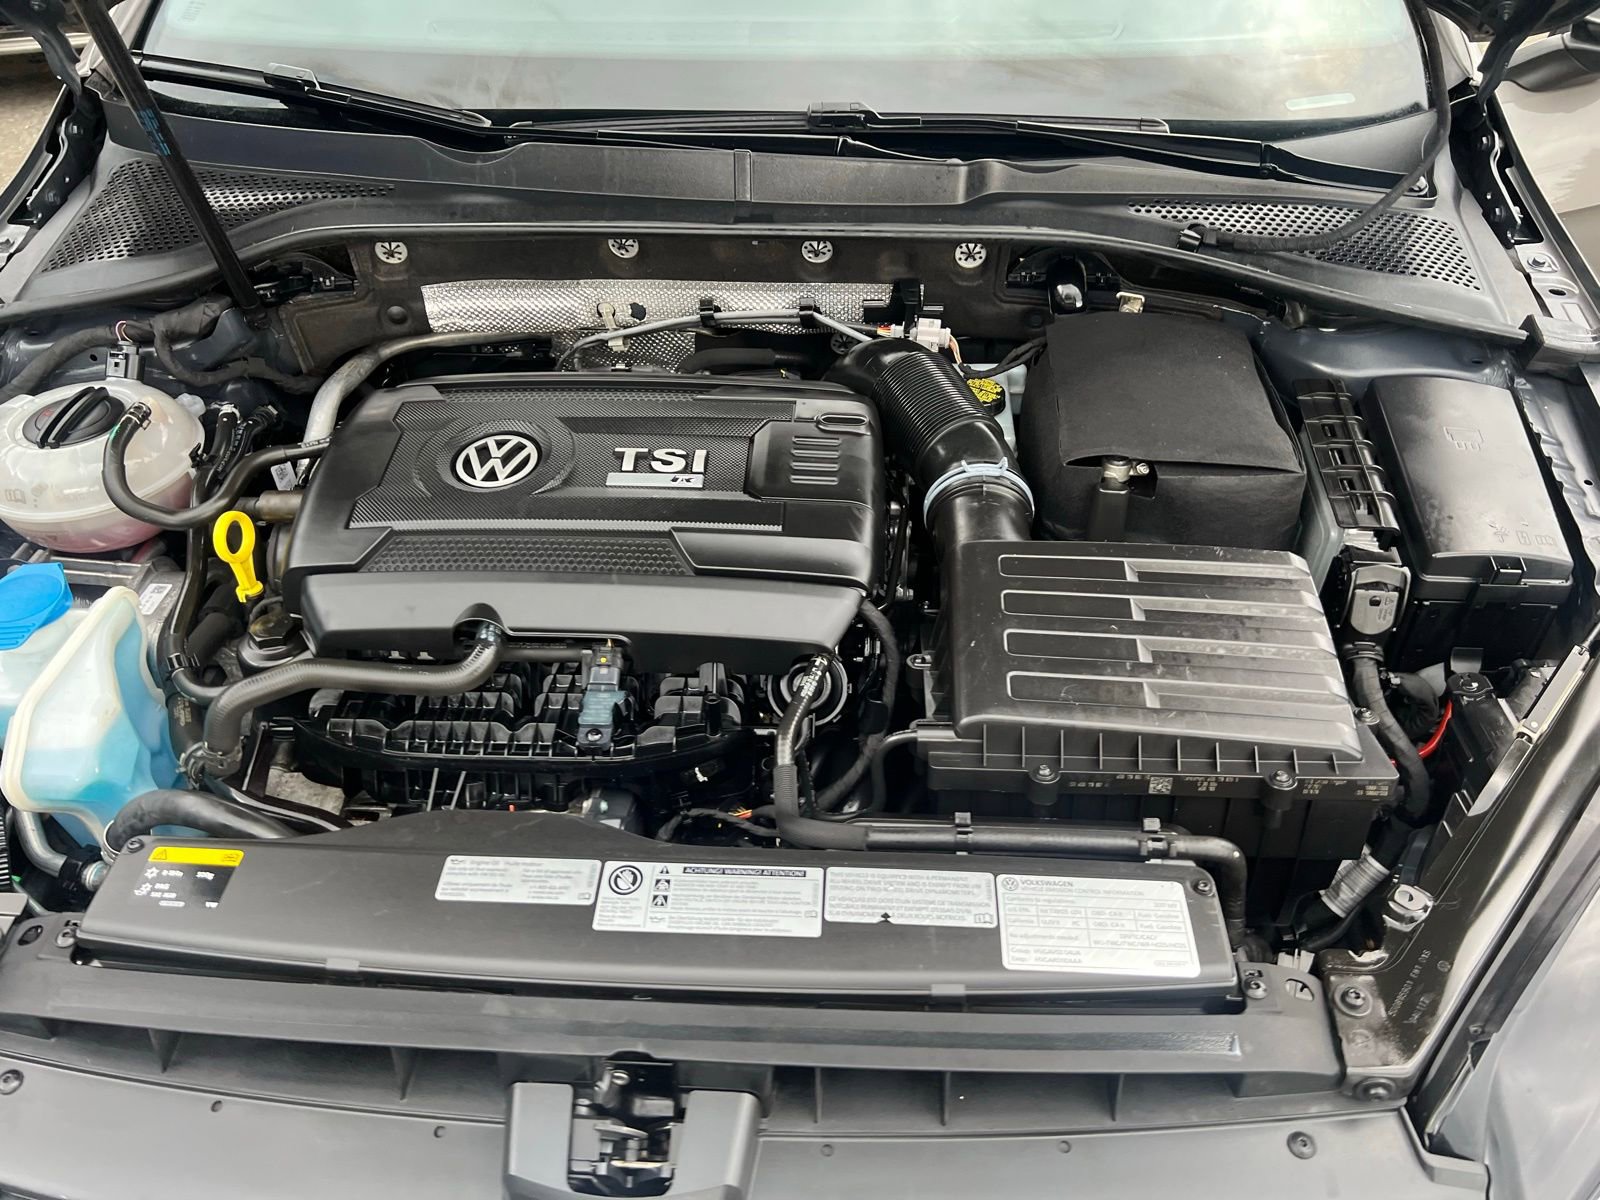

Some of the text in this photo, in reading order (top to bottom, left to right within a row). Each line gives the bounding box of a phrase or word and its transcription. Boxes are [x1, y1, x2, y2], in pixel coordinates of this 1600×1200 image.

[614, 447, 708, 473] TSI
[686, 866, 805, 877] ACHTUNG! WARNING! ATTENTION!
[1020, 878, 1073, 887] VOLKSWAGEN
